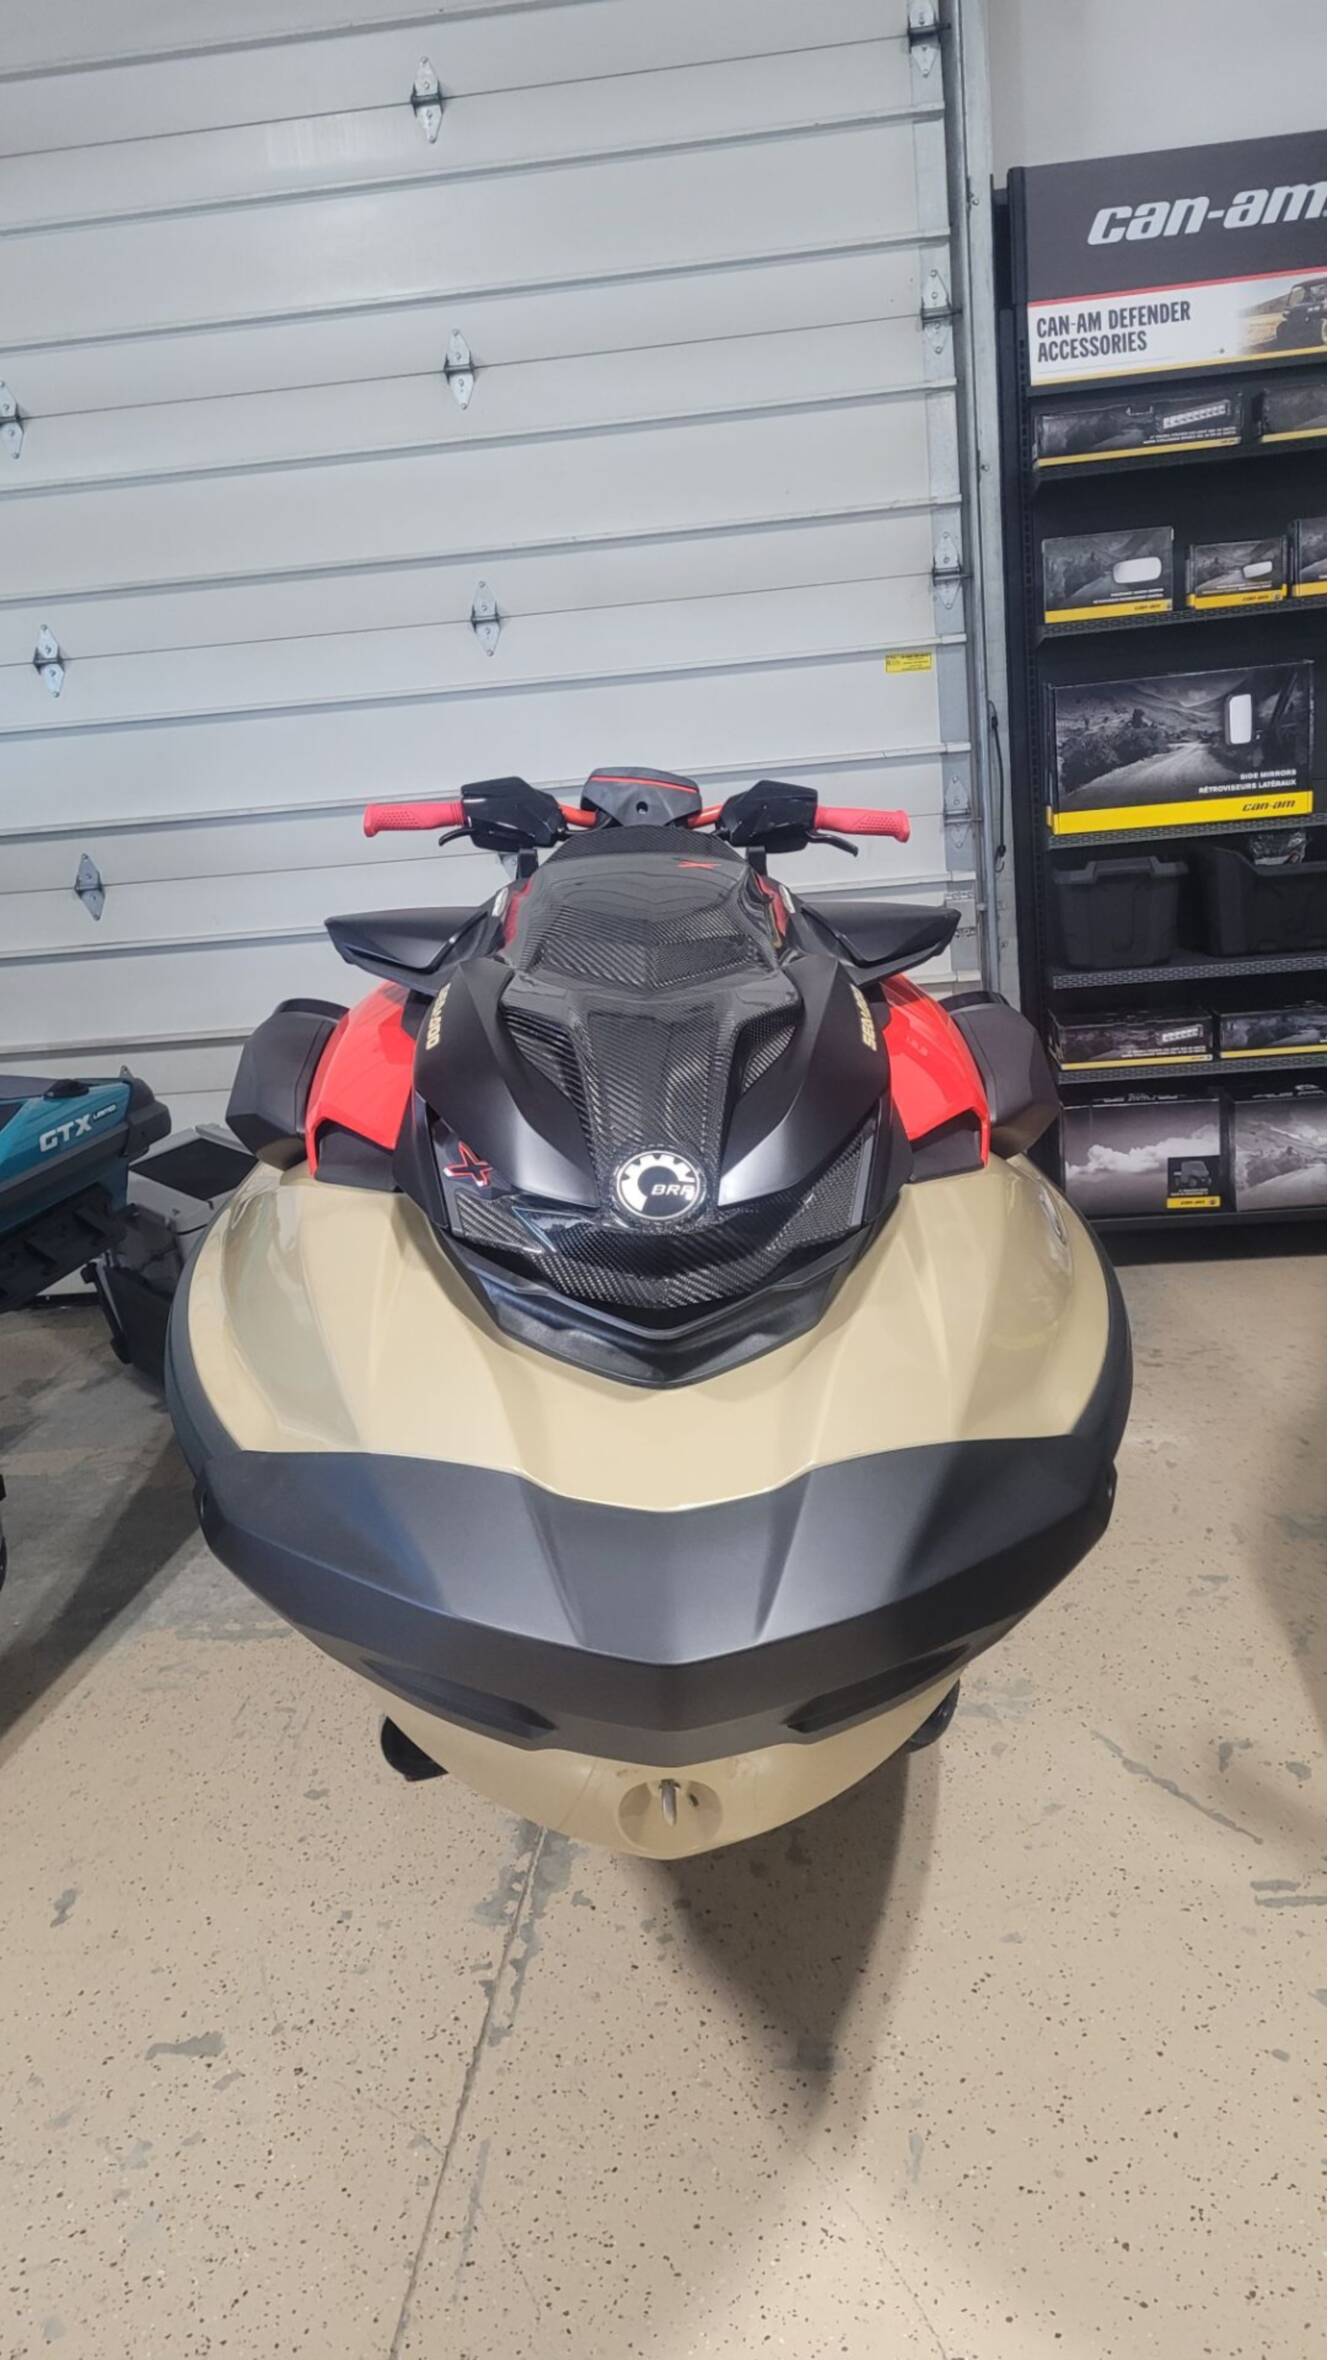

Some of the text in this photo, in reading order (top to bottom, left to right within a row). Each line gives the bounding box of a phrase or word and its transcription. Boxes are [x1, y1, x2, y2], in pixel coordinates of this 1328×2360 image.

[1036, 300, 1191, 338] CAN-AM DEFENDER
[1038, 330, 1148, 363] ACCESSORIES
[1198, 778, 1297, 794] RÉTROVISEURS LATÉRAUX
[1240, 768, 1297, 781] SIDE MIRRORS
[1242, 799, 1296, 812] can-am
[39, 1113, 93, 1153] GTX
